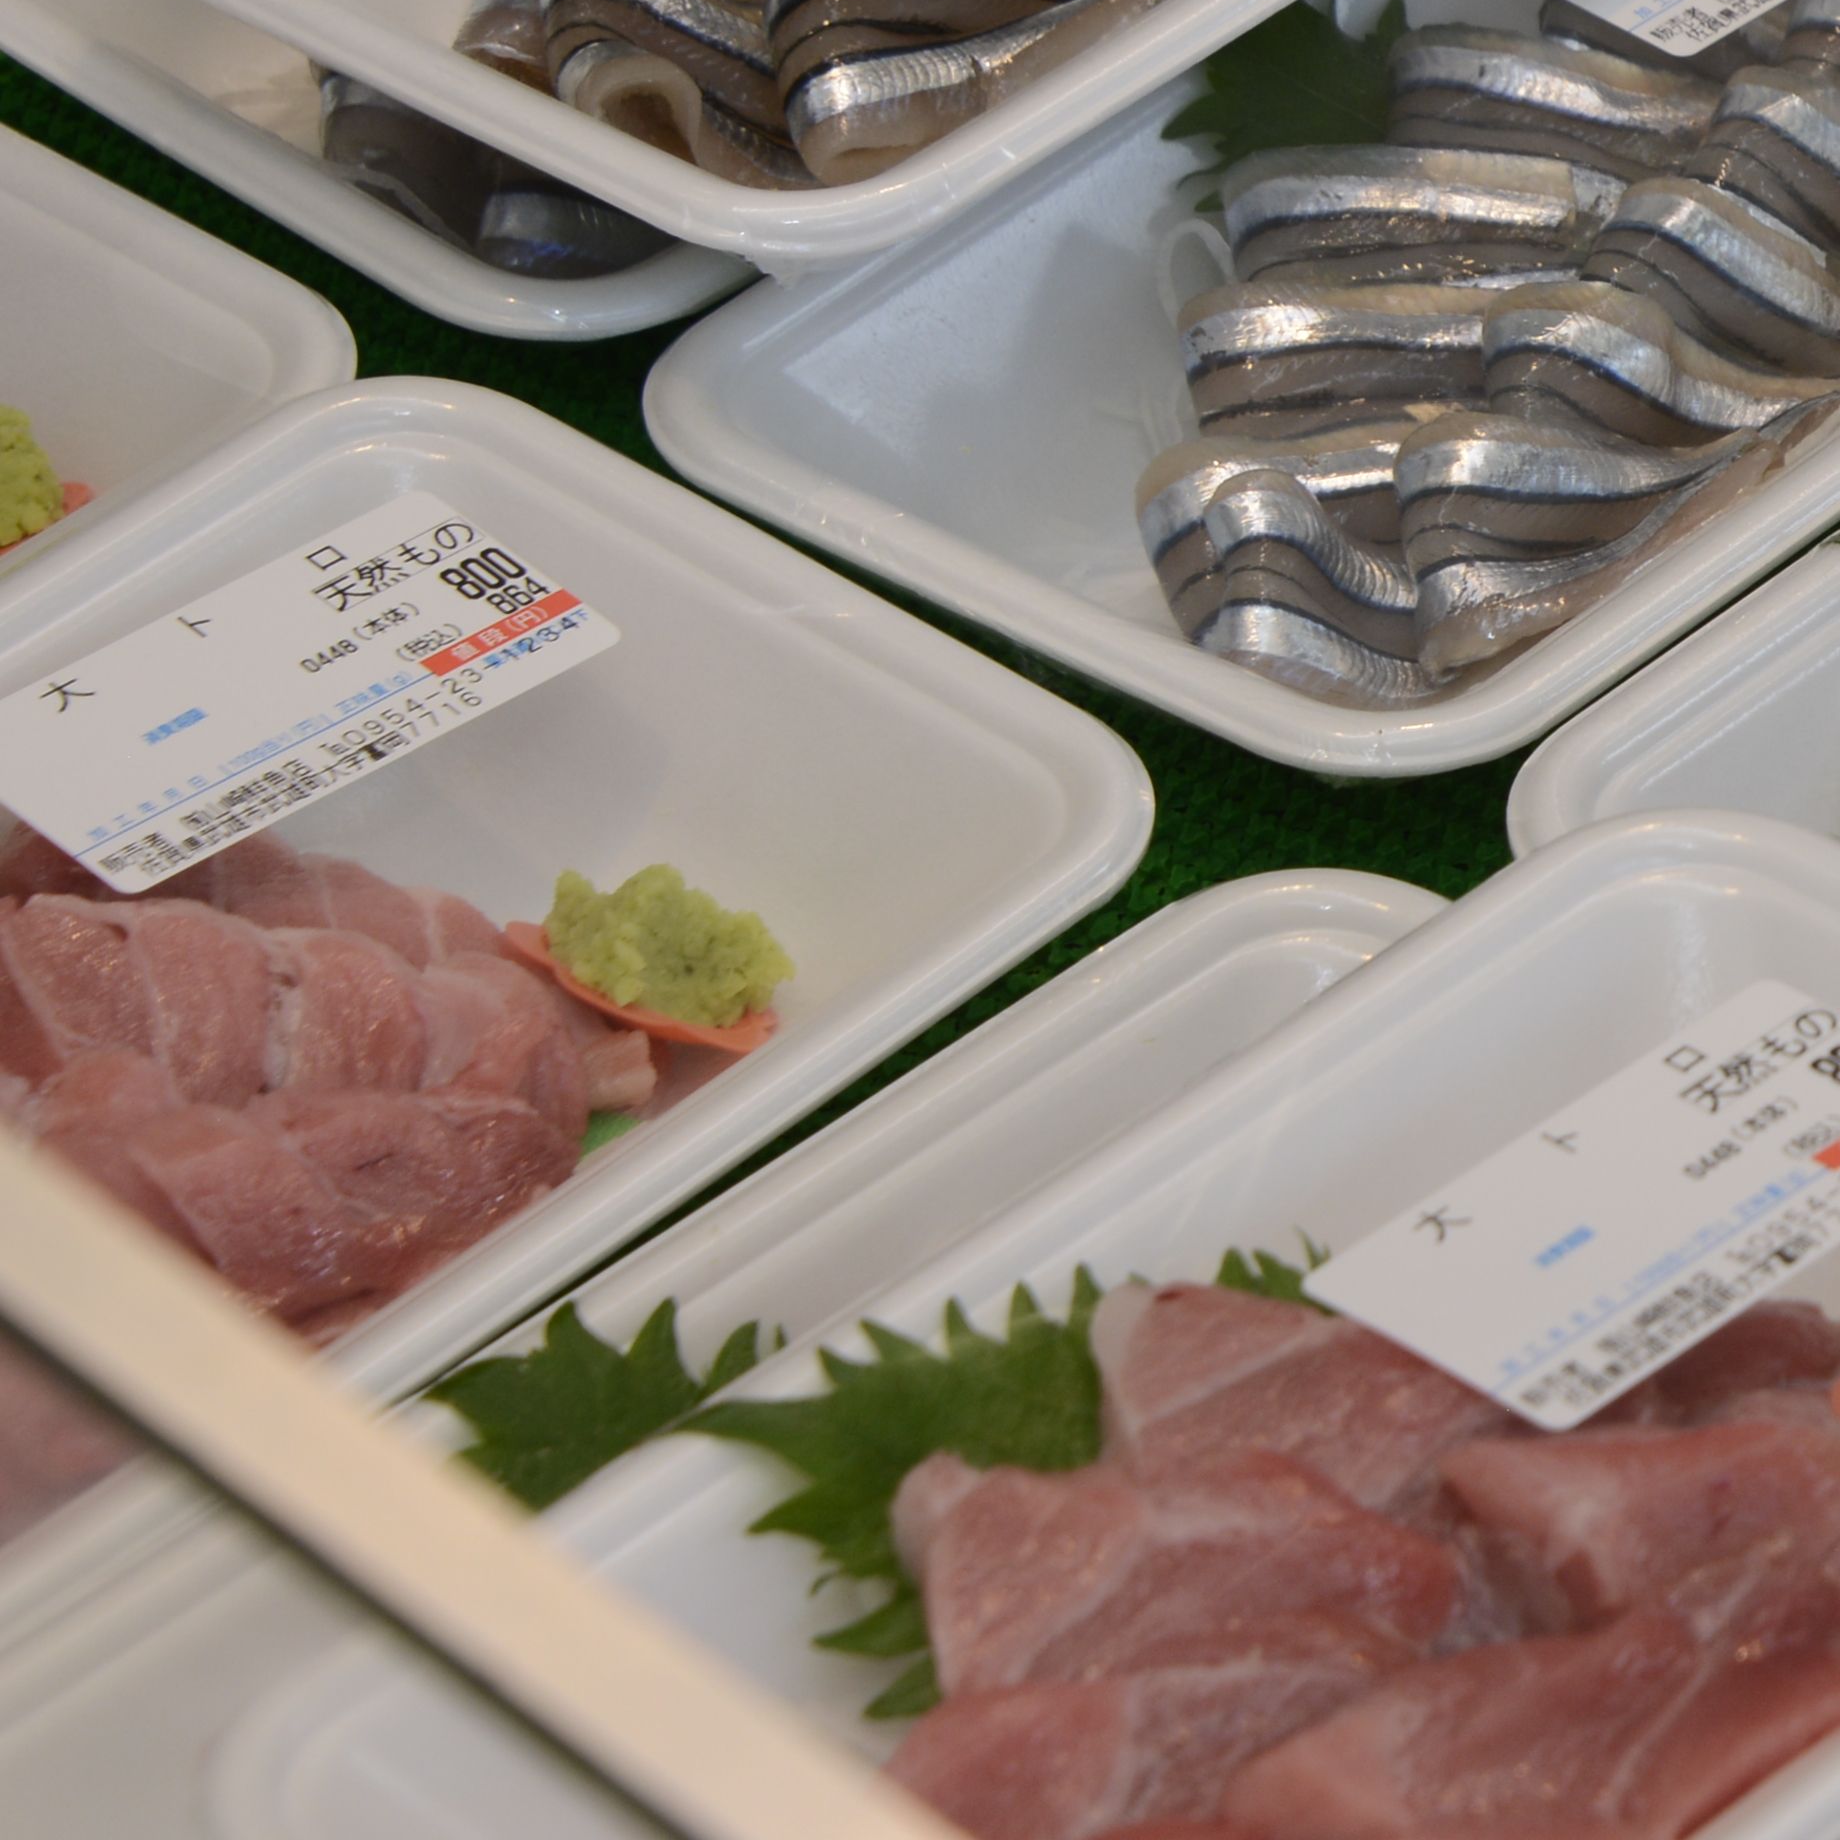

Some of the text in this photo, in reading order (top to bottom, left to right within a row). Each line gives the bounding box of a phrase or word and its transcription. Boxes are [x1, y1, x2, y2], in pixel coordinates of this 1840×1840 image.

[39, 544, 348, 713] 大トロ
[300, 547, 527, 673] 0448(本体) 800
[314, 523, 474, 611] 天然もの
[395, 576, 550, 662] (税込) 864
[1409, 1042, 1710, 1244] 大トロ
